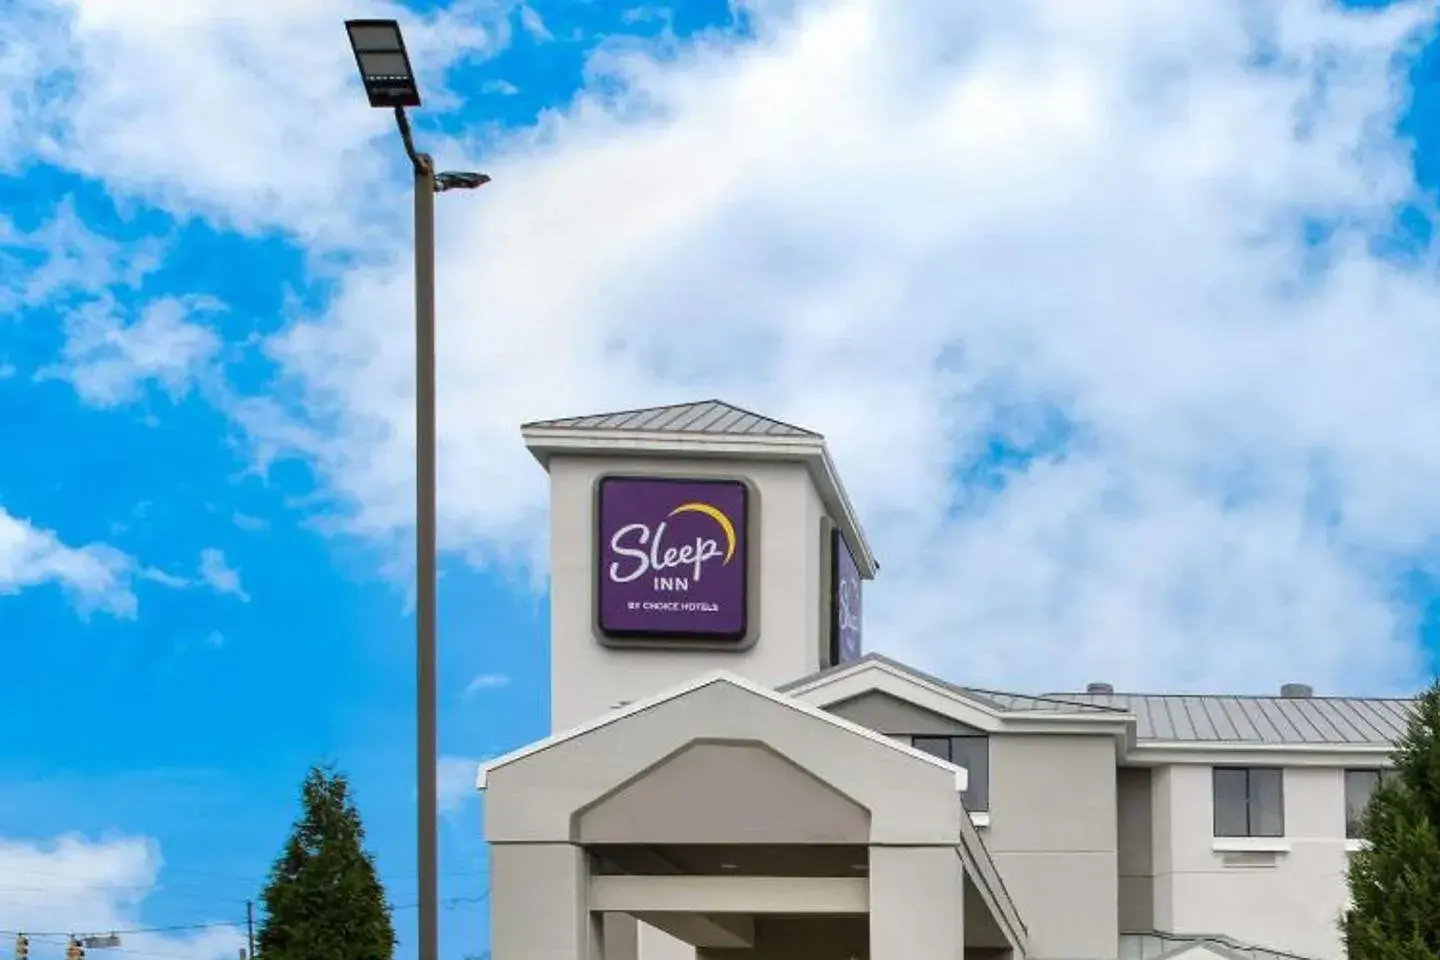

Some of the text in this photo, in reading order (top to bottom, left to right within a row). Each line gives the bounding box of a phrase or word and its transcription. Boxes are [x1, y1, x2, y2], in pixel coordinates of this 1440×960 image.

[610, 521, 723, 582] Sleep
[653, 577, 689, 591] INN
[627, 602, 719, 612] BY CHOICE HOTELS
